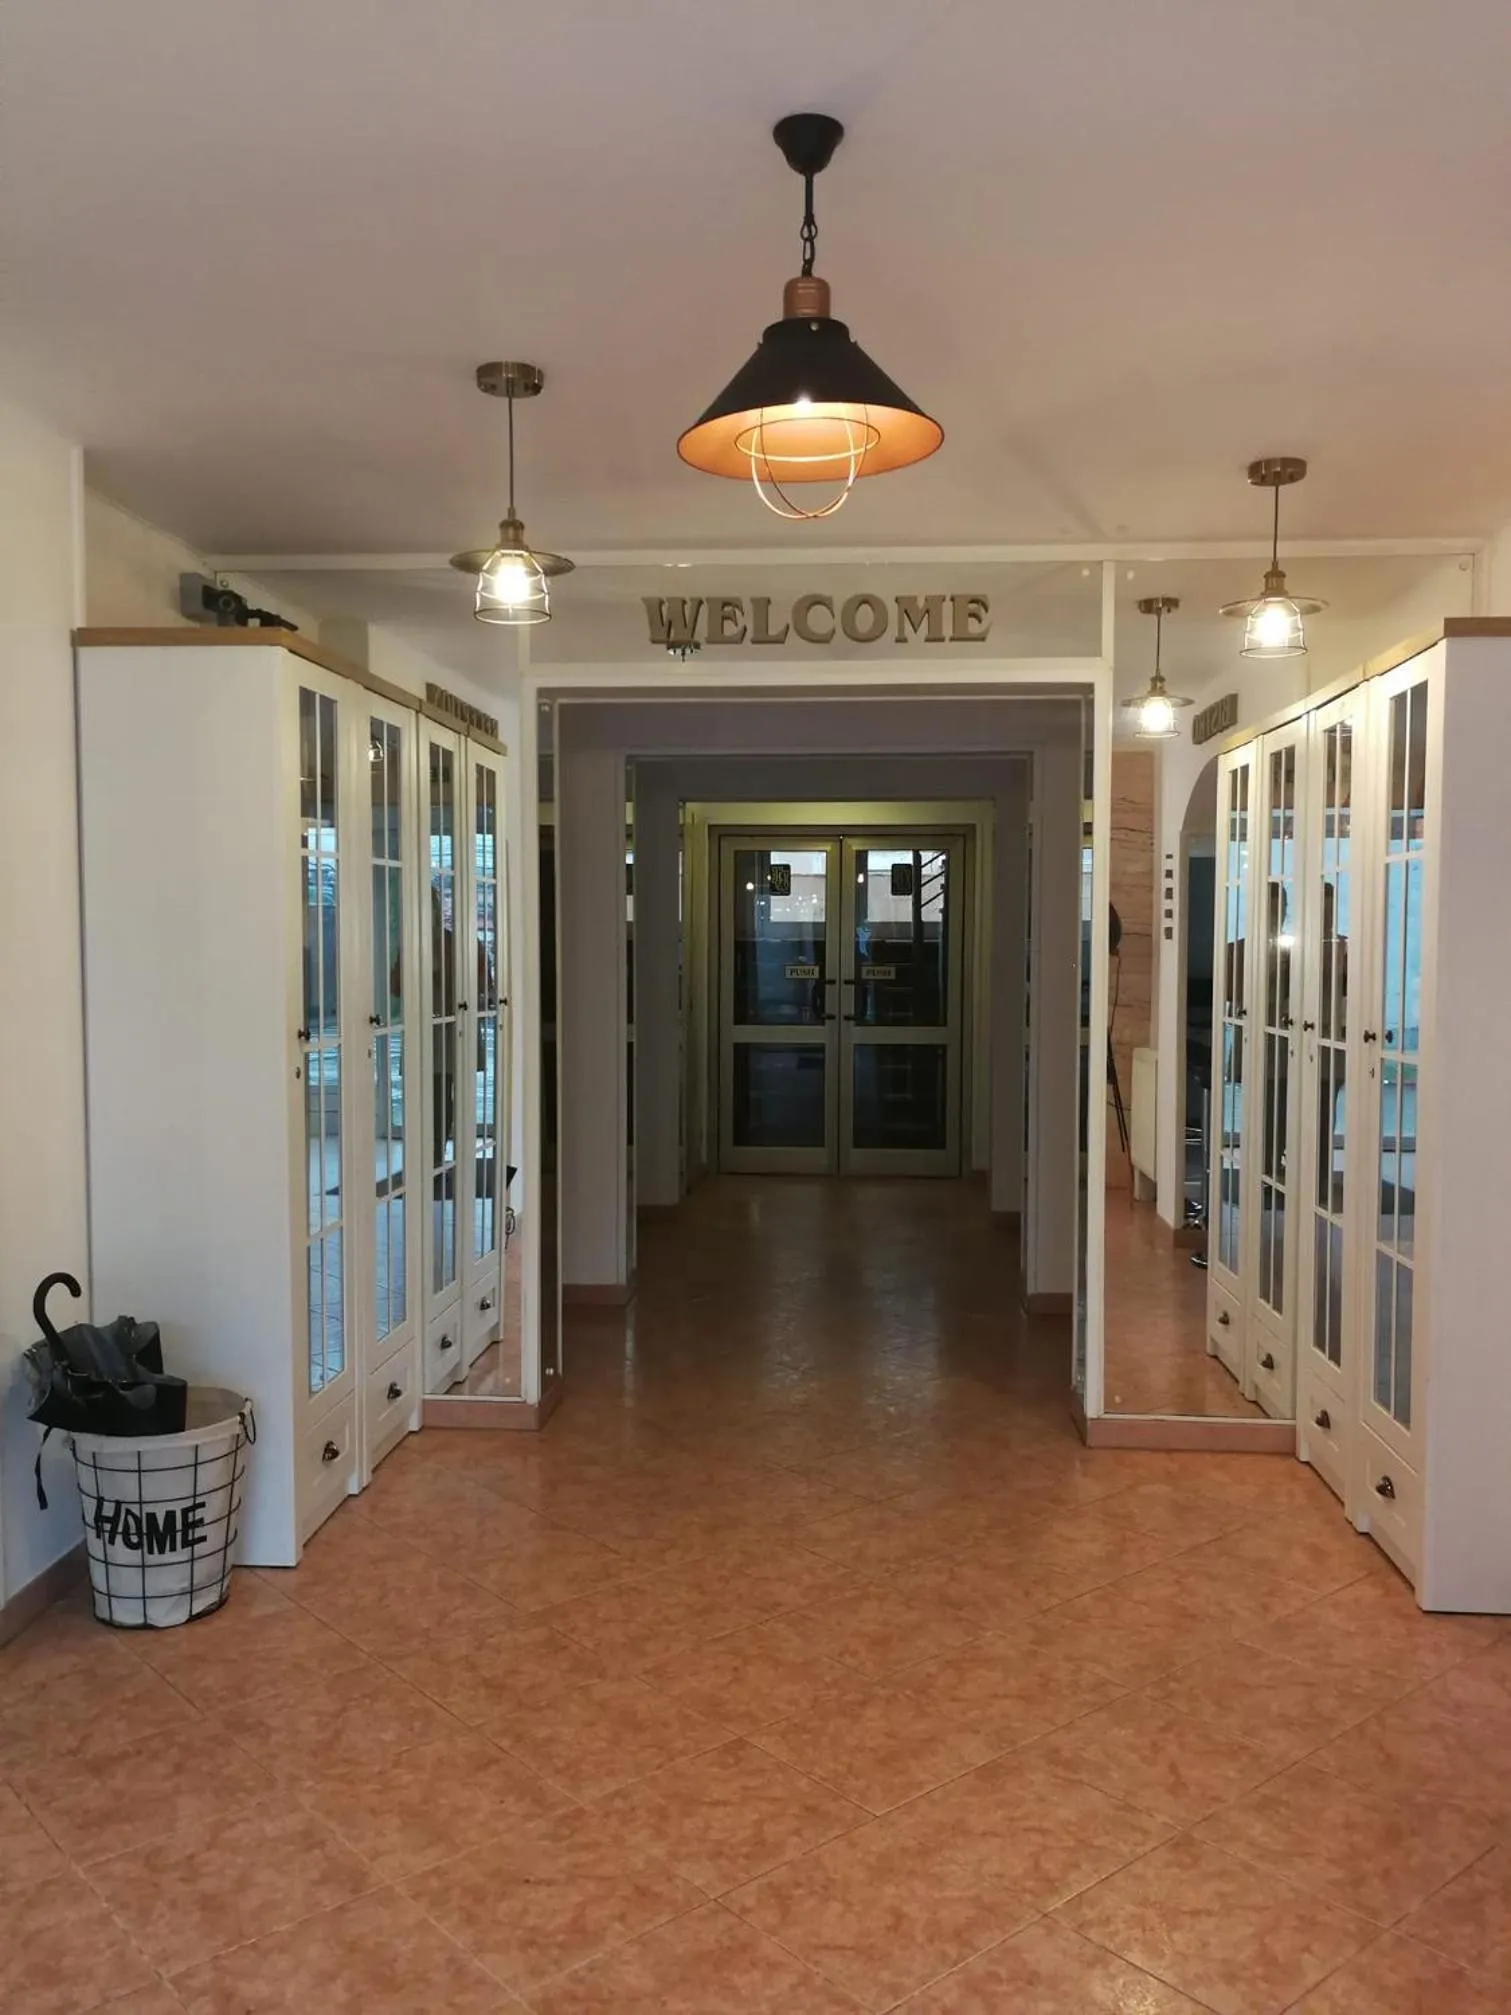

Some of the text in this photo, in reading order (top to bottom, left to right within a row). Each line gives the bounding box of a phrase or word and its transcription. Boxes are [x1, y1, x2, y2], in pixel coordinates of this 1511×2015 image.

[641, 593, 993, 645] WELCOME
[789, 967, 815, 977] PUSH
[94, 1496, 207, 1555] HOME
